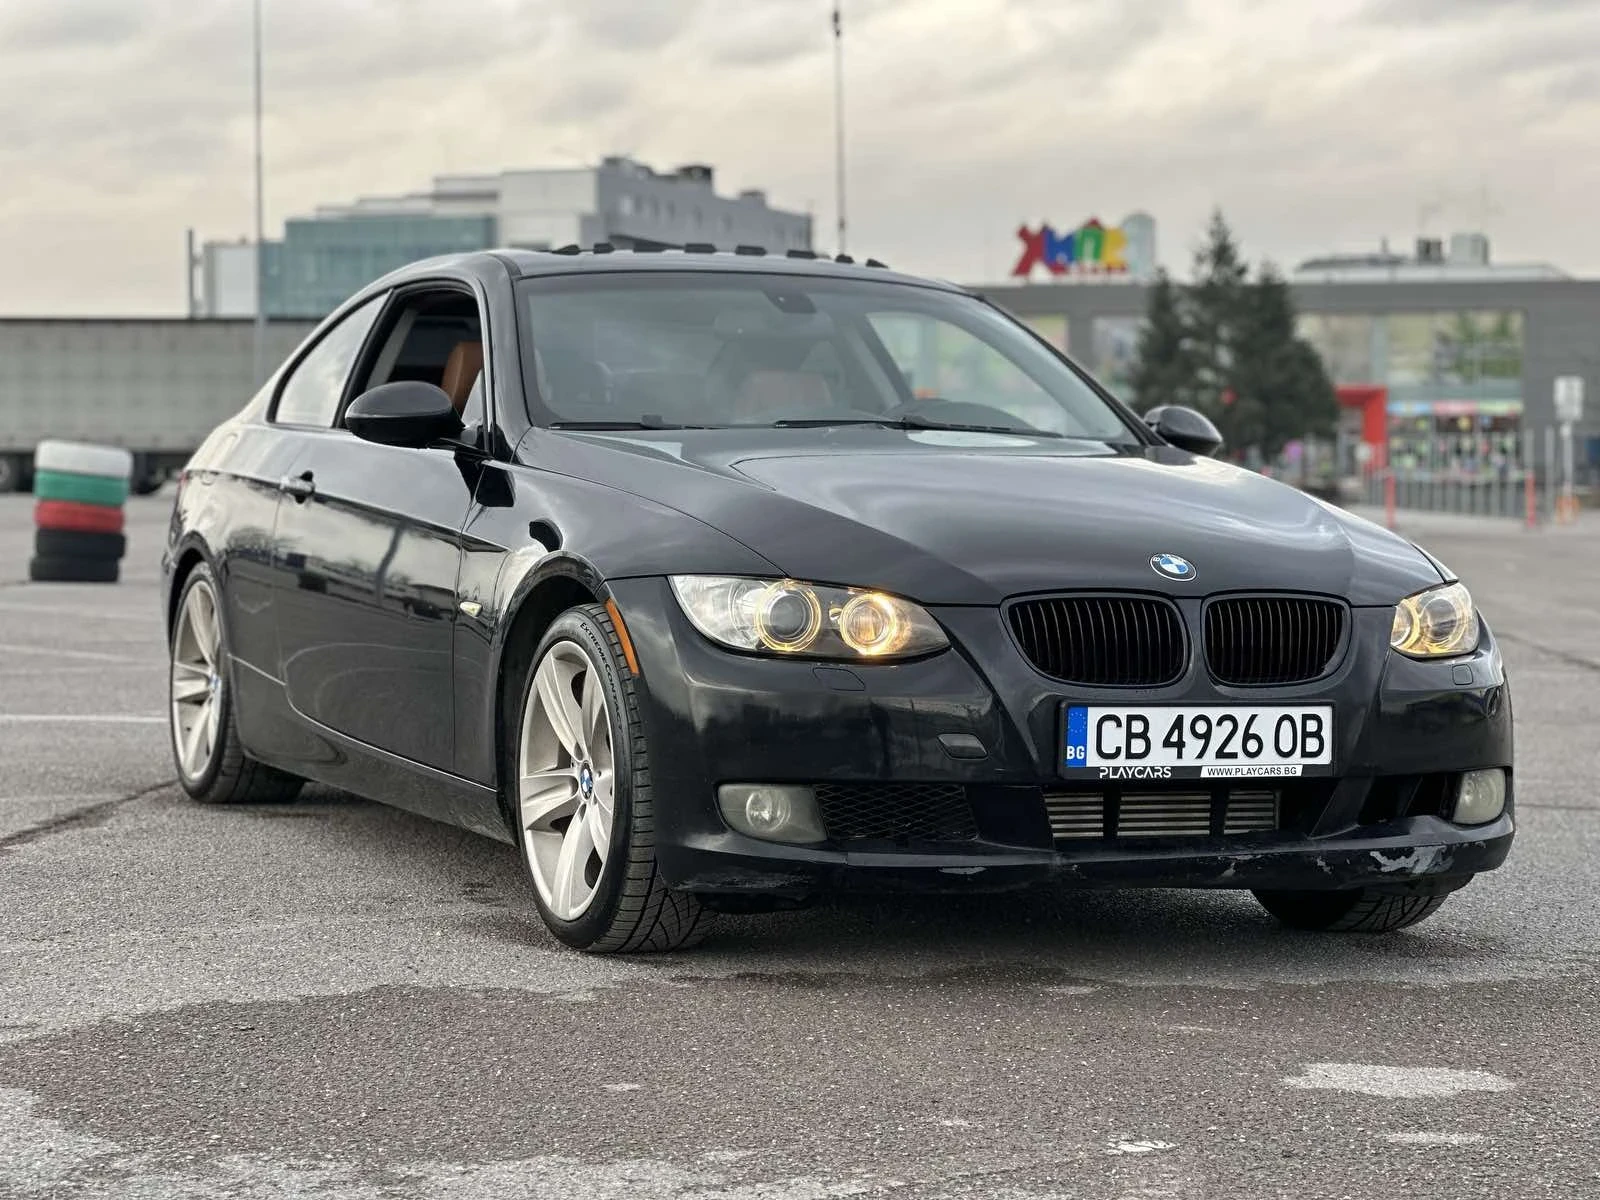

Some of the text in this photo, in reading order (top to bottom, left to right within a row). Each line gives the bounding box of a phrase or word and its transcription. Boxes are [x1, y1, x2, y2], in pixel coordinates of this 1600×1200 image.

[1096, 714, 1151, 759] CB
[1162, 714, 1264, 759] 4926
[1066, 746, 1085, 760] BG
[1100, 767, 1172, 779] PLAYCARS
[1207, 767, 1297, 776] WWW.PLAYCARS.BG
